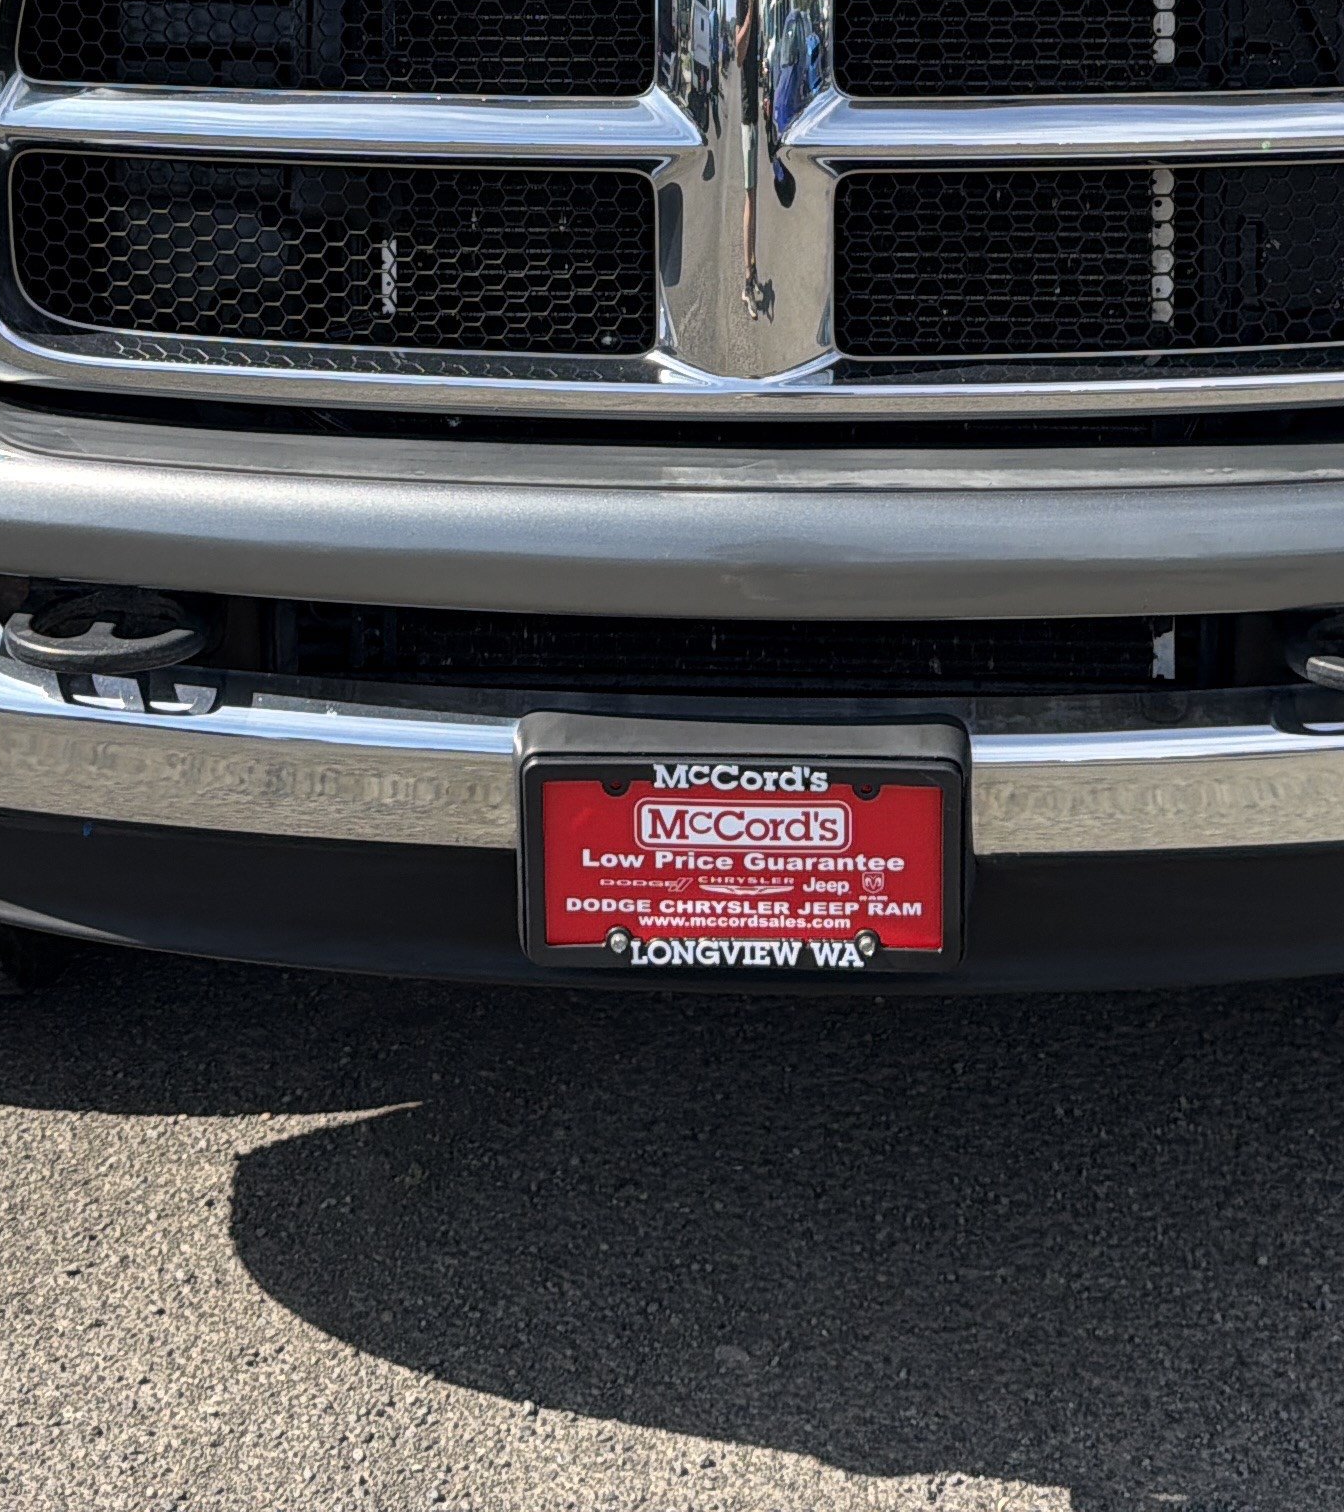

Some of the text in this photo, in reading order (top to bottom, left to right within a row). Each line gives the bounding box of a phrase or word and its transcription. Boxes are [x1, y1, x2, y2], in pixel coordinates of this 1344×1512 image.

[653, 763, 828, 792] McCord's
[648, 808, 839, 842] McCord's
[582, 848, 905, 872] Low Price Guarantee
[697, 876, 795, 885] CHRYSLER
[802, 877, 850, 896] Jeep
[566, 897, 923, 917] DODGE CHRYSLER JEEP RAM
[638, 914, 851, 929] www.mccordsales.com
[630, 940, 865, 968] LONGVIEW WA
